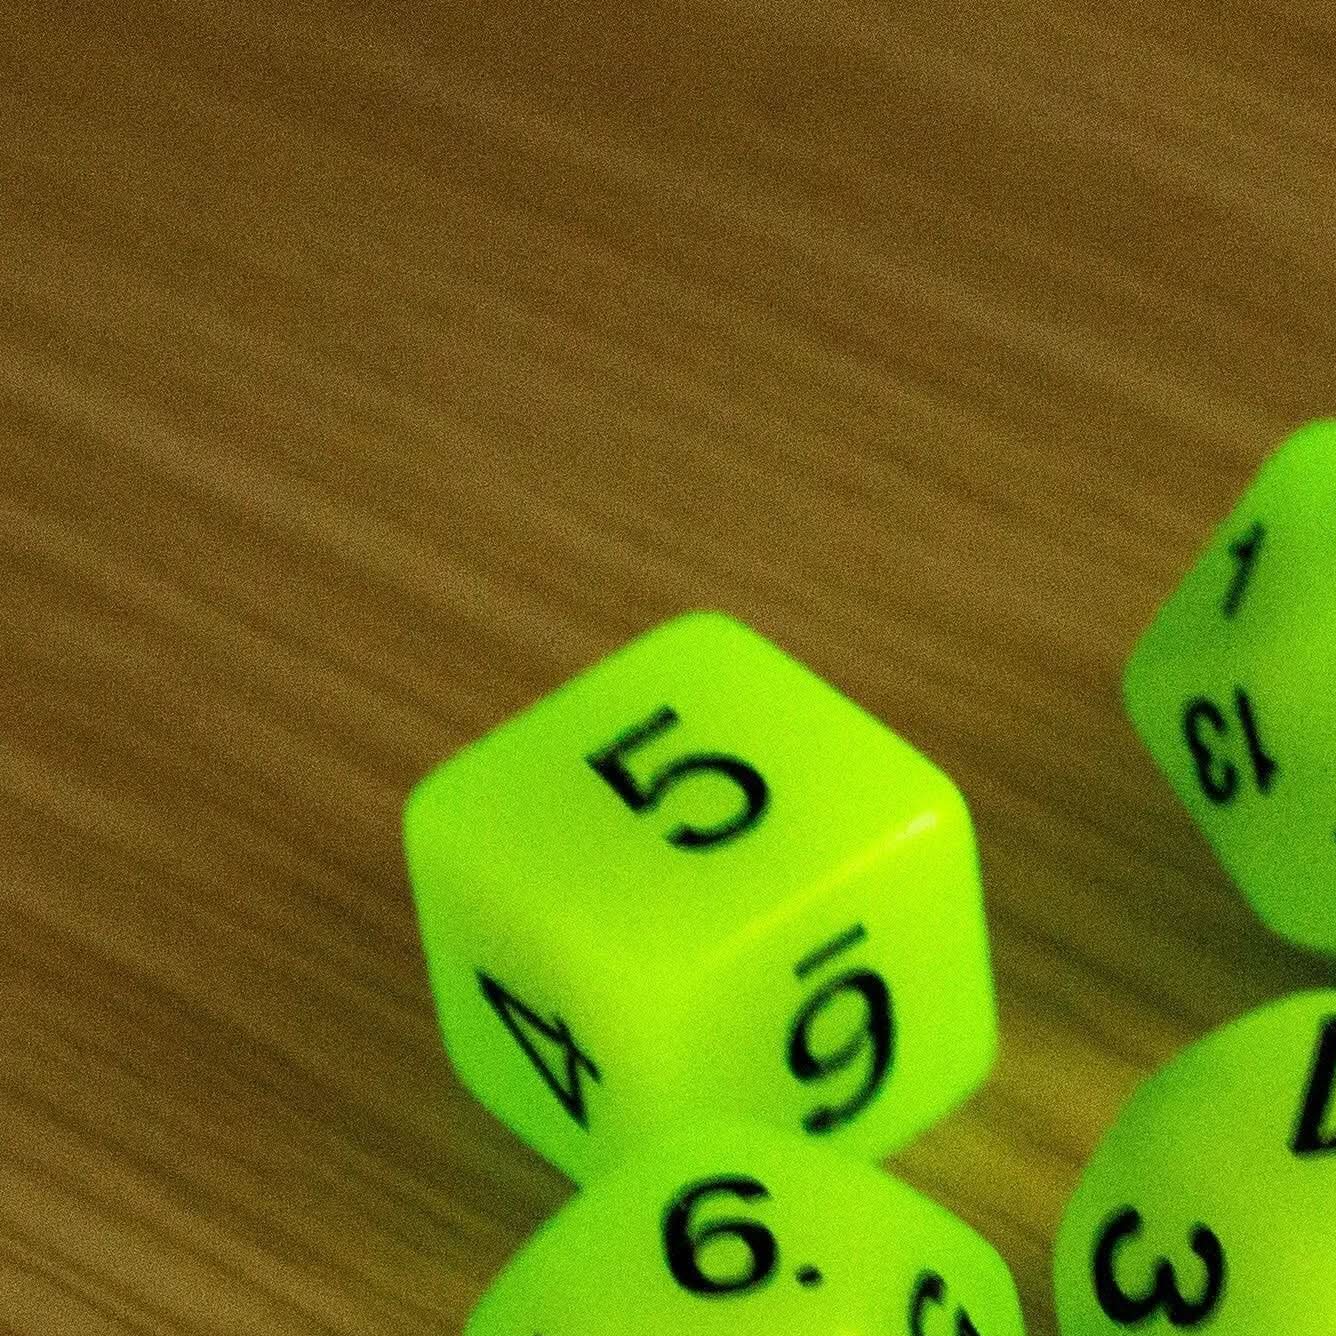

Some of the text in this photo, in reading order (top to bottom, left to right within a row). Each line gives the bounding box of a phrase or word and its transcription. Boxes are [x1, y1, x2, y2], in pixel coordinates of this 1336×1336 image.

[586, 707, 772, 853] 5
[1180, 689, 1279, 808] 13
[472, 965, 603, 1132] 4
[1089, 1205, 1228, 1332] 3
